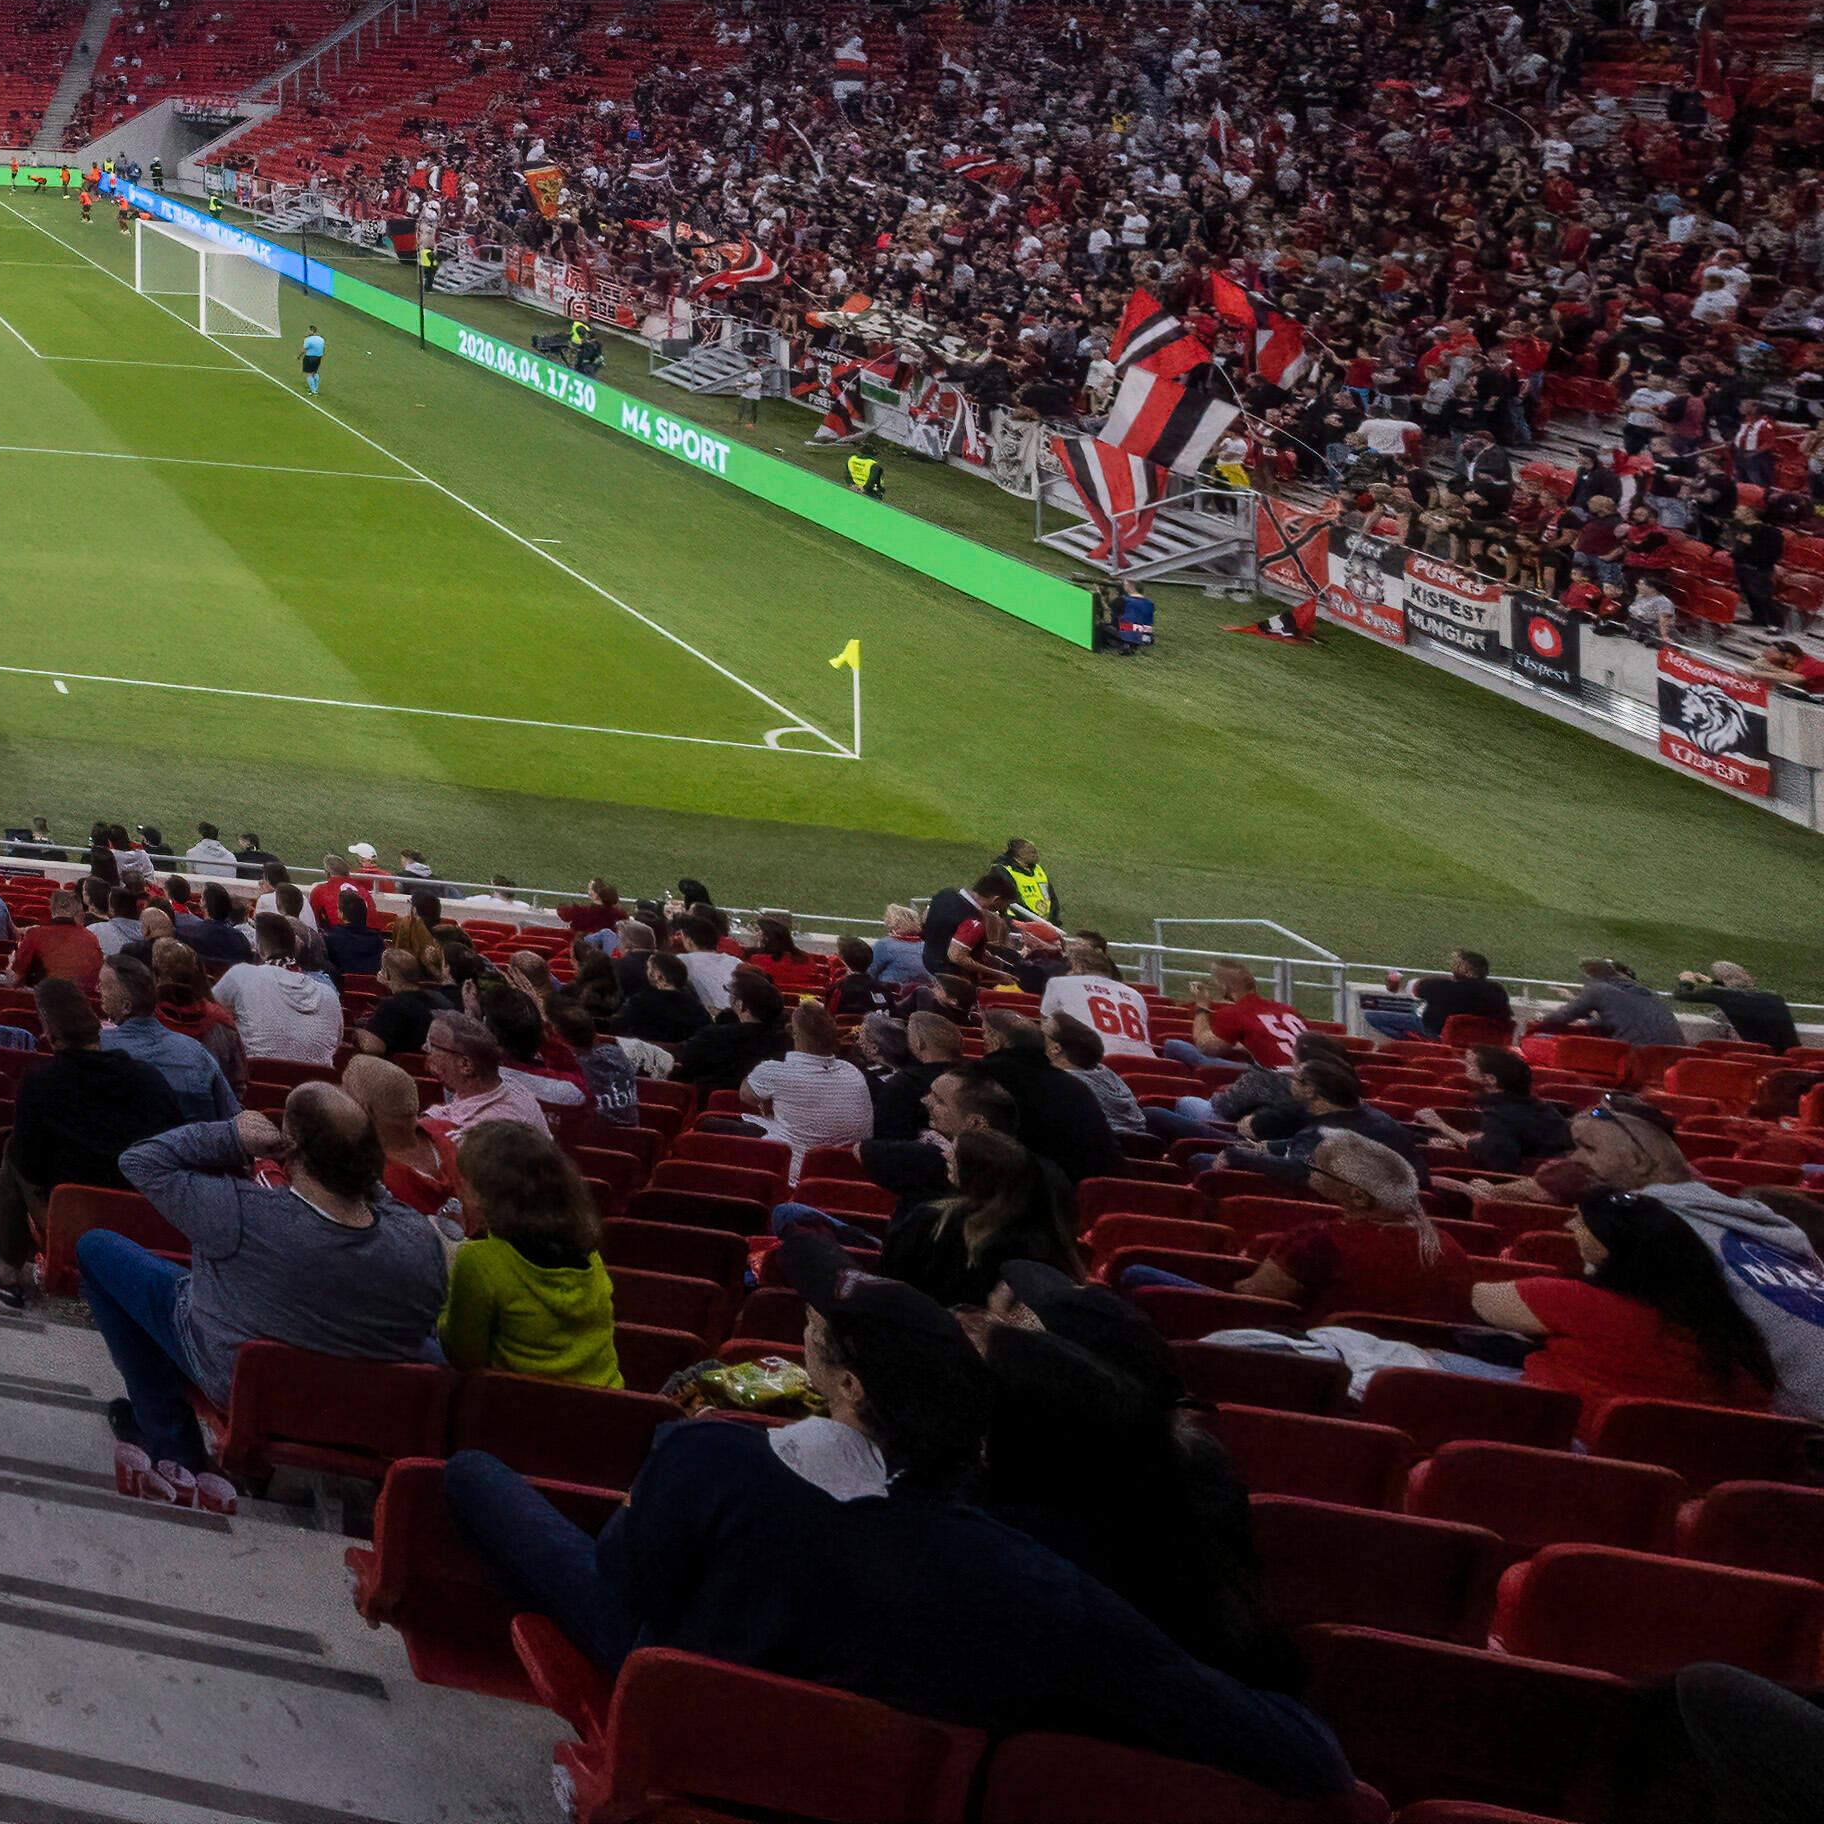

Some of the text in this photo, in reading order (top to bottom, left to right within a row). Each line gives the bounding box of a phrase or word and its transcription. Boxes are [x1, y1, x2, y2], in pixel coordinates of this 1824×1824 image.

[457, 329, 731, 474] 2020.06.04. 17:30 M4 SPORT
[1410, 583, 1486, 623] KISPEST
[1087, 996, 1146, 1042] 66
[1739, 1262, 1824, 1292] NAS
